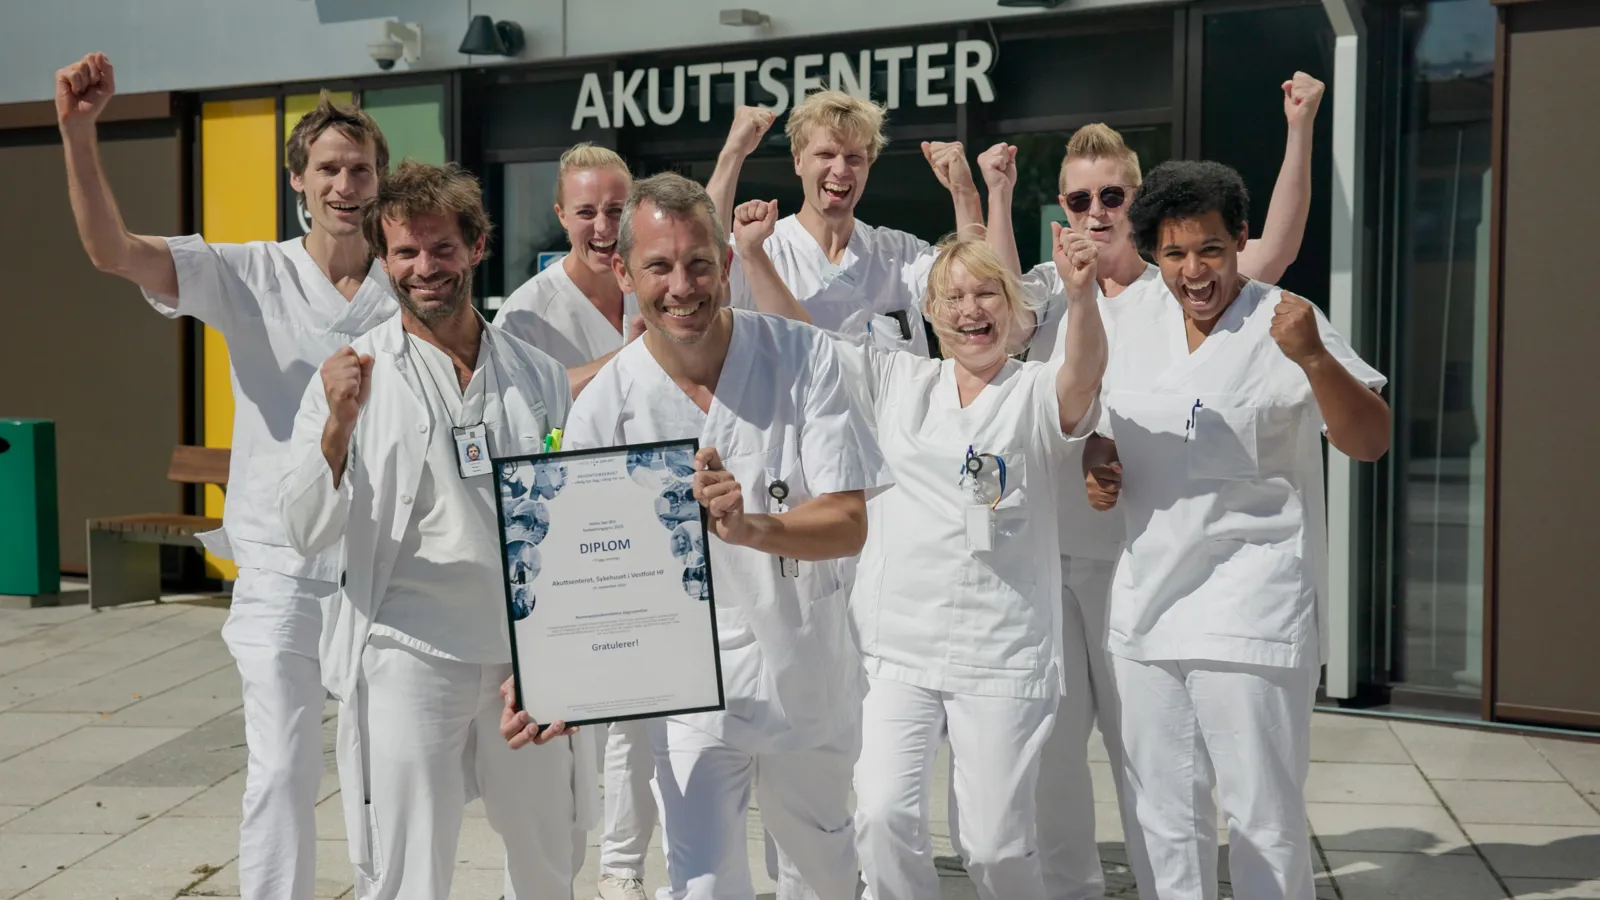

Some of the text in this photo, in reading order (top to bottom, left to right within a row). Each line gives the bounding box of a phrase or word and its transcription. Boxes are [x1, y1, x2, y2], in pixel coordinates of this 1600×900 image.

[571, 40, 995, 131] AKUTTSENTER
[580, 539, 631, 554] DIPLOM
[552, 576, 595, 587] Akuttsenteret,
[596, 574, 627, 583] Sykehuset
[631, 570, 655, 579] Vestfold
[591, 639, 639, 652] Gratulerer!
